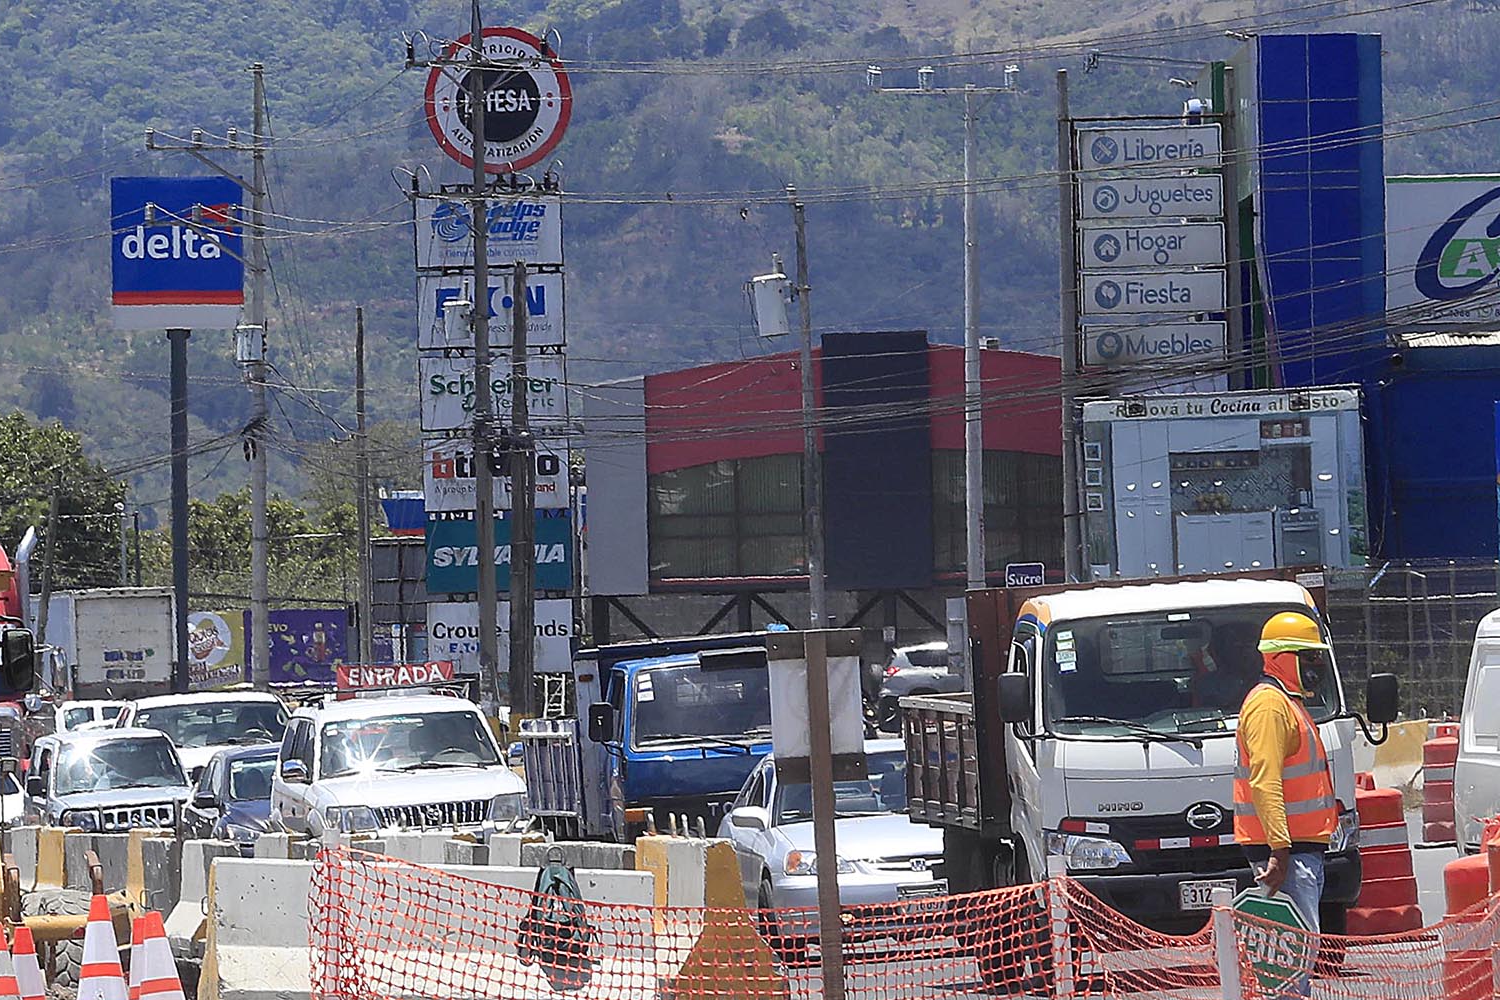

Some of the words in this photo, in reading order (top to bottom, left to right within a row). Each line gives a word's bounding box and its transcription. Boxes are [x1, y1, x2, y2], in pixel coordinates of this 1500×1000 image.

[1123, 137, 1204, 161] Librería
[1124, 183, 1214, 215] Juguetes
[121, 225, 221, 260] delta
[1125, 230, 1187, 265] Hogar
[1125, 281, 1192, 305] Fiesta
[1125, 334, 1213, 356] Muebles
[430, 372, 558, 395] Scheier
[1186, 402, 1203, 415] tu
[1210, 398, 1261, 415] Cocina
[1268, 397, 1284, 411] al
[433, 543, 565, 567] SYLAIA
[1008, 574, 1042, 586] Sucre
[348, 664, 446, 687] ENTRADA
[1098, 801, 1143, 812] HINO
